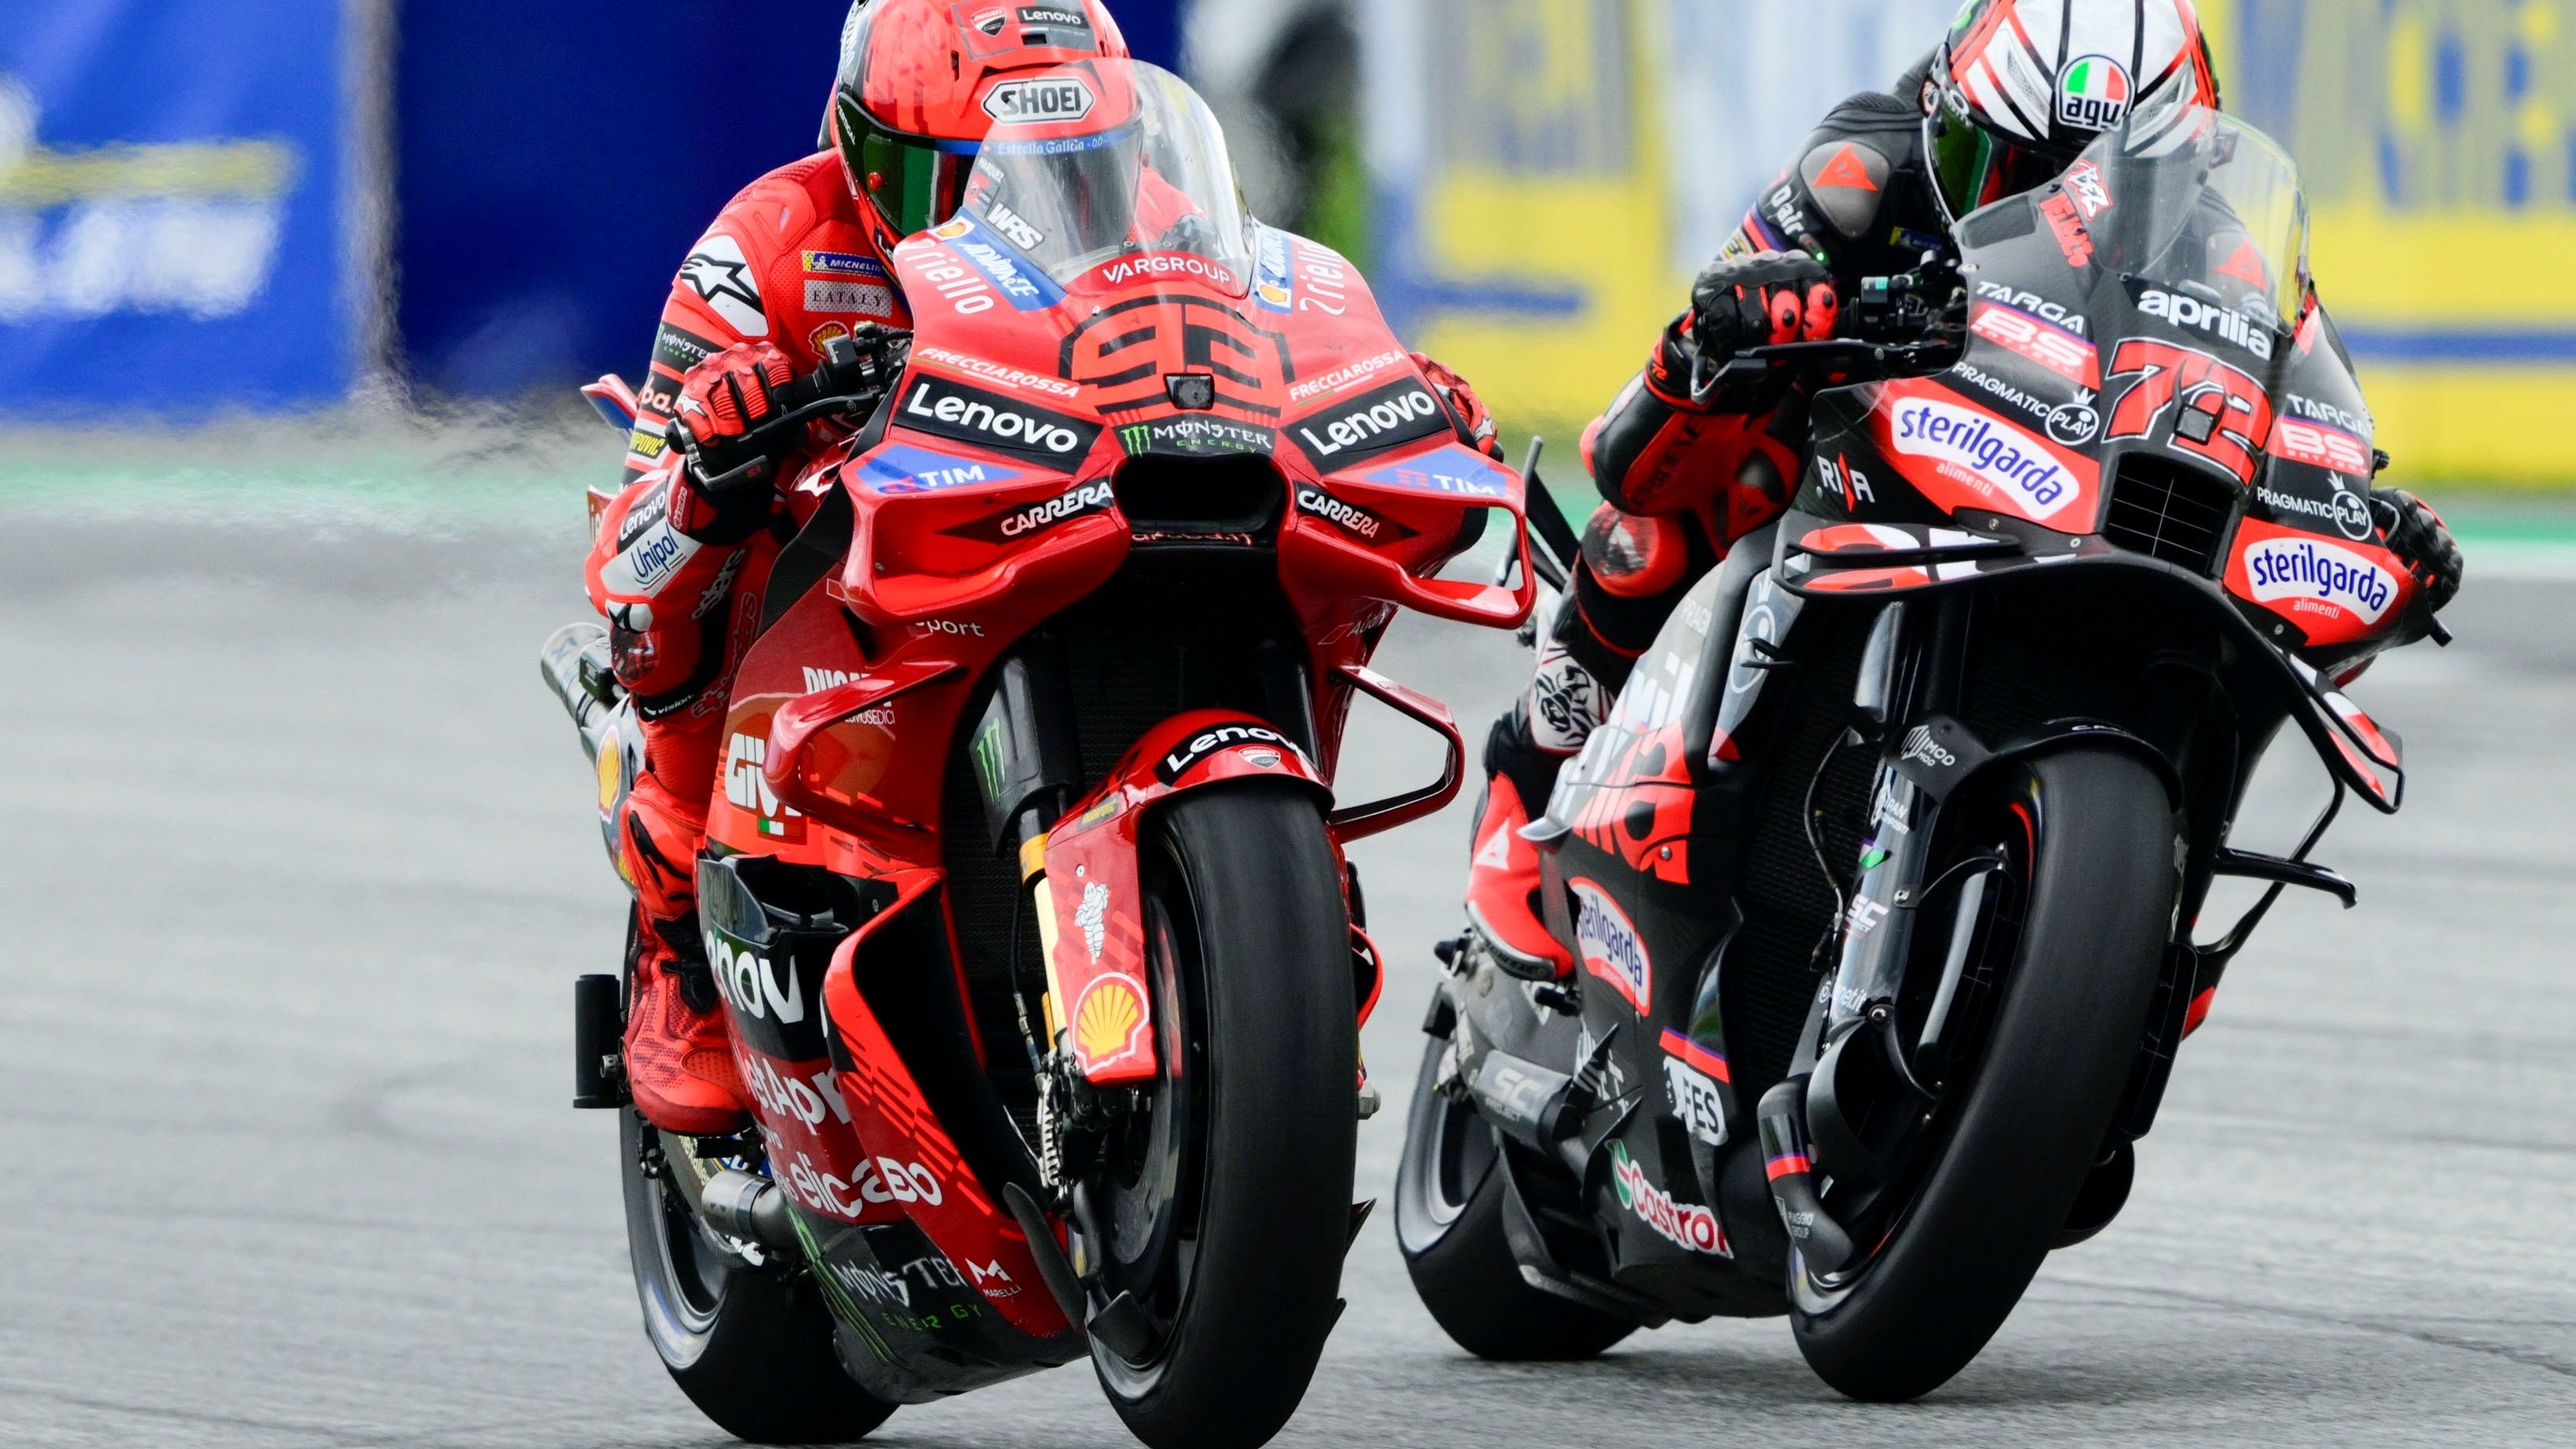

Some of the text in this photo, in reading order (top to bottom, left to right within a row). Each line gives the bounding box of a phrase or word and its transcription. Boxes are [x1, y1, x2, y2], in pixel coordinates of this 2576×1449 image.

[1022, 9, 1082, 25] Lenovo
[1001, 85, 1082, 115] SHOEI
[2065, 96, 2122, 125] agv
[997, 141, 1045, 155] Estrella
[1046, 139, 1085, 156] Galicia
[987, 202, 1044, 250] WRS
[830, 258, 882, 272] MICHELIN
[1102, 256, 1231, 284] VARGROUP
[812, 289, 883, 308] EATALY
[1975, 280, 2085, 334] TARGA
[1975, 308, 2091, 367] BS
[2137, 289, 2273, 361] aprilia
[917, 347, 1083, 398] FRECCIAROSSA
[1289, 349, 1406, 402] FRECCIAROSSA
[907, 382, 1079, 453] Lenovo
[1952, 361, 2095, 437] PRAGMATIC PLAY
[2100, 335, 2275, 489] 72
[1153, 419, 1273, 450] MONSTER
[1175, 437, 1257, 454] ENERGY
[1300, 390, 1437, 457] Lenovo
[2279, 422, 2366, 467] BS
[918, 464, 986, 488] TIM
[1901, 406, 2064, 506] sterilgarda
[1935, 460, 1994, 498] alimenti
[1432, 473, 1497, 495] TIM
[2256, 486, 2368, 527] PRAGMATIC PLAY
[620, 490, 666, 542] Lenovo
[1000, 481, 1115, 536] CARRERA
[1297, 489, 1380, 539] CARRERA
[631, 520, 679, 579] Unipol
[2252, 543, 2389, 612] sterilgarda
[2293, 597, 2342, 620] alimenti
